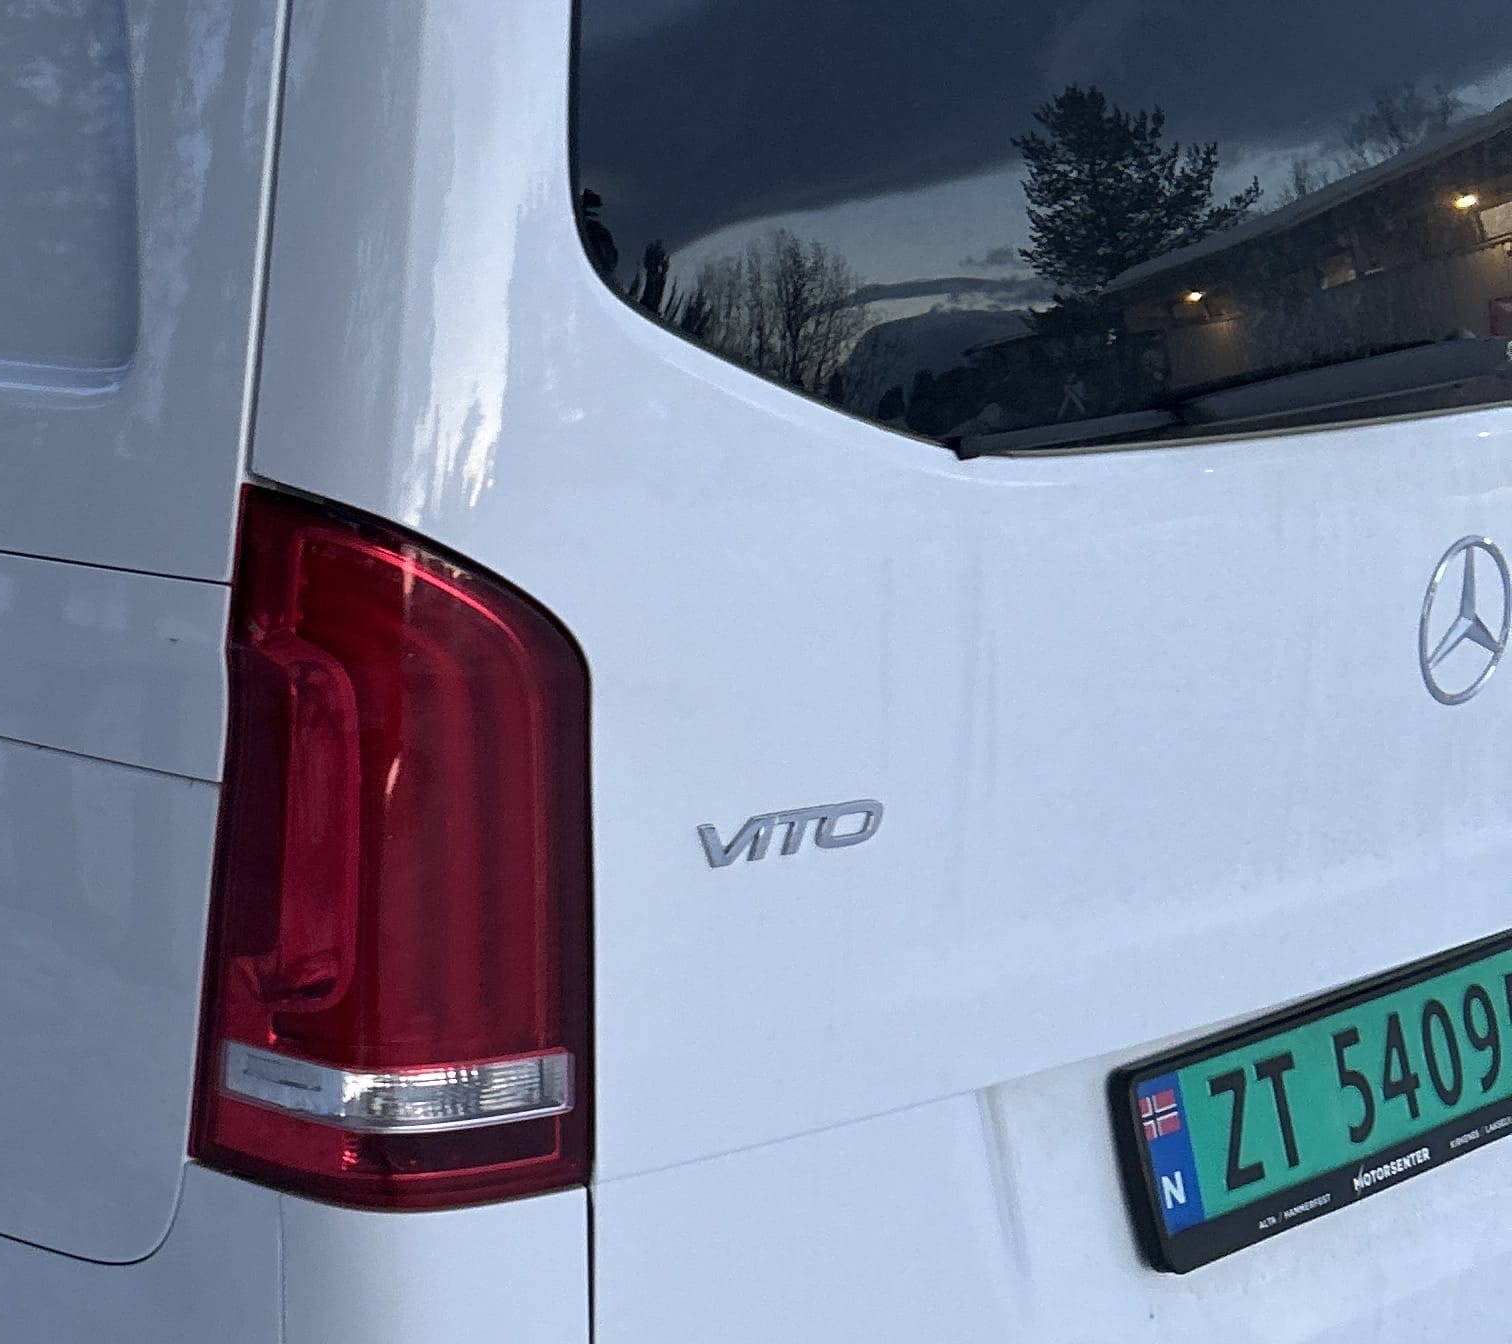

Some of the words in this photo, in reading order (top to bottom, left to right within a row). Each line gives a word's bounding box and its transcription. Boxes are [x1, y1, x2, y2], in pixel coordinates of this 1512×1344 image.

[696, 799, 885, 868] VITO
[1208, 1052, 1299, 1191] ZT
[1333, 975, 1512, 1143] 5409
[1161, 1171, 1186, 1209] N
[1353, 1147, 1431, 1192] MOTORSENTER
